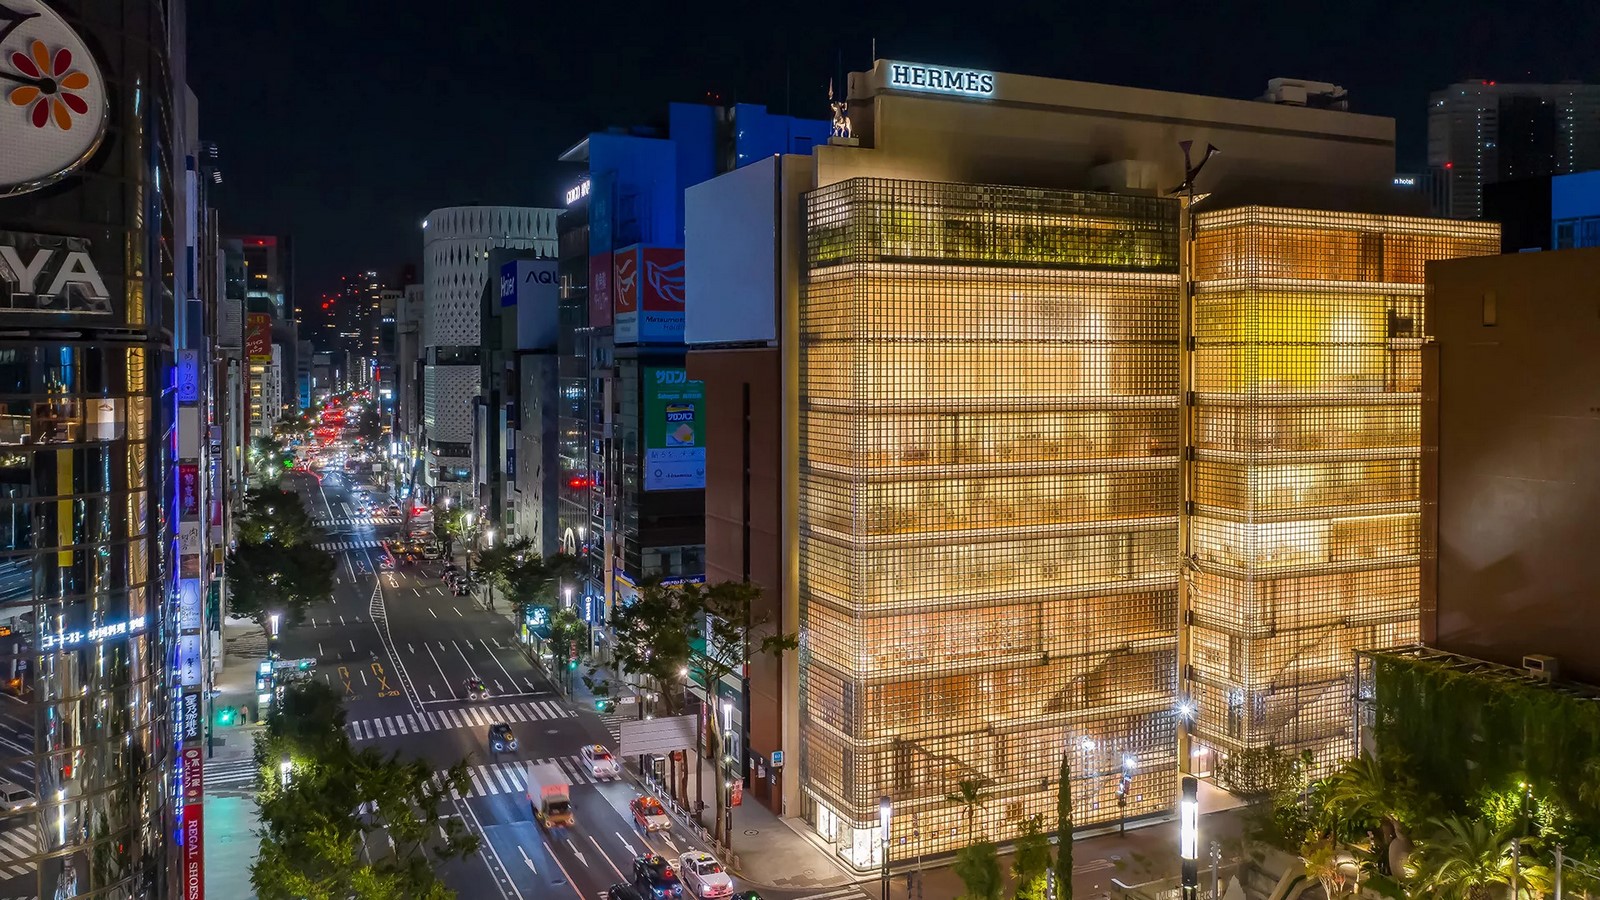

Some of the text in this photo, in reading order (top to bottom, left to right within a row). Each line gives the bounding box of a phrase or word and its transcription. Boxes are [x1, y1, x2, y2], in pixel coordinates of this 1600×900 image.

[892, 64, 993, 94] HERMÈS
[184, 693, 198, 738] 星乃珈琲店
[184, 759, 192, 788] レストラン
[191, 758, 201, 787] 不二家
[188, 819, 200, 900] REGAL SHOES
